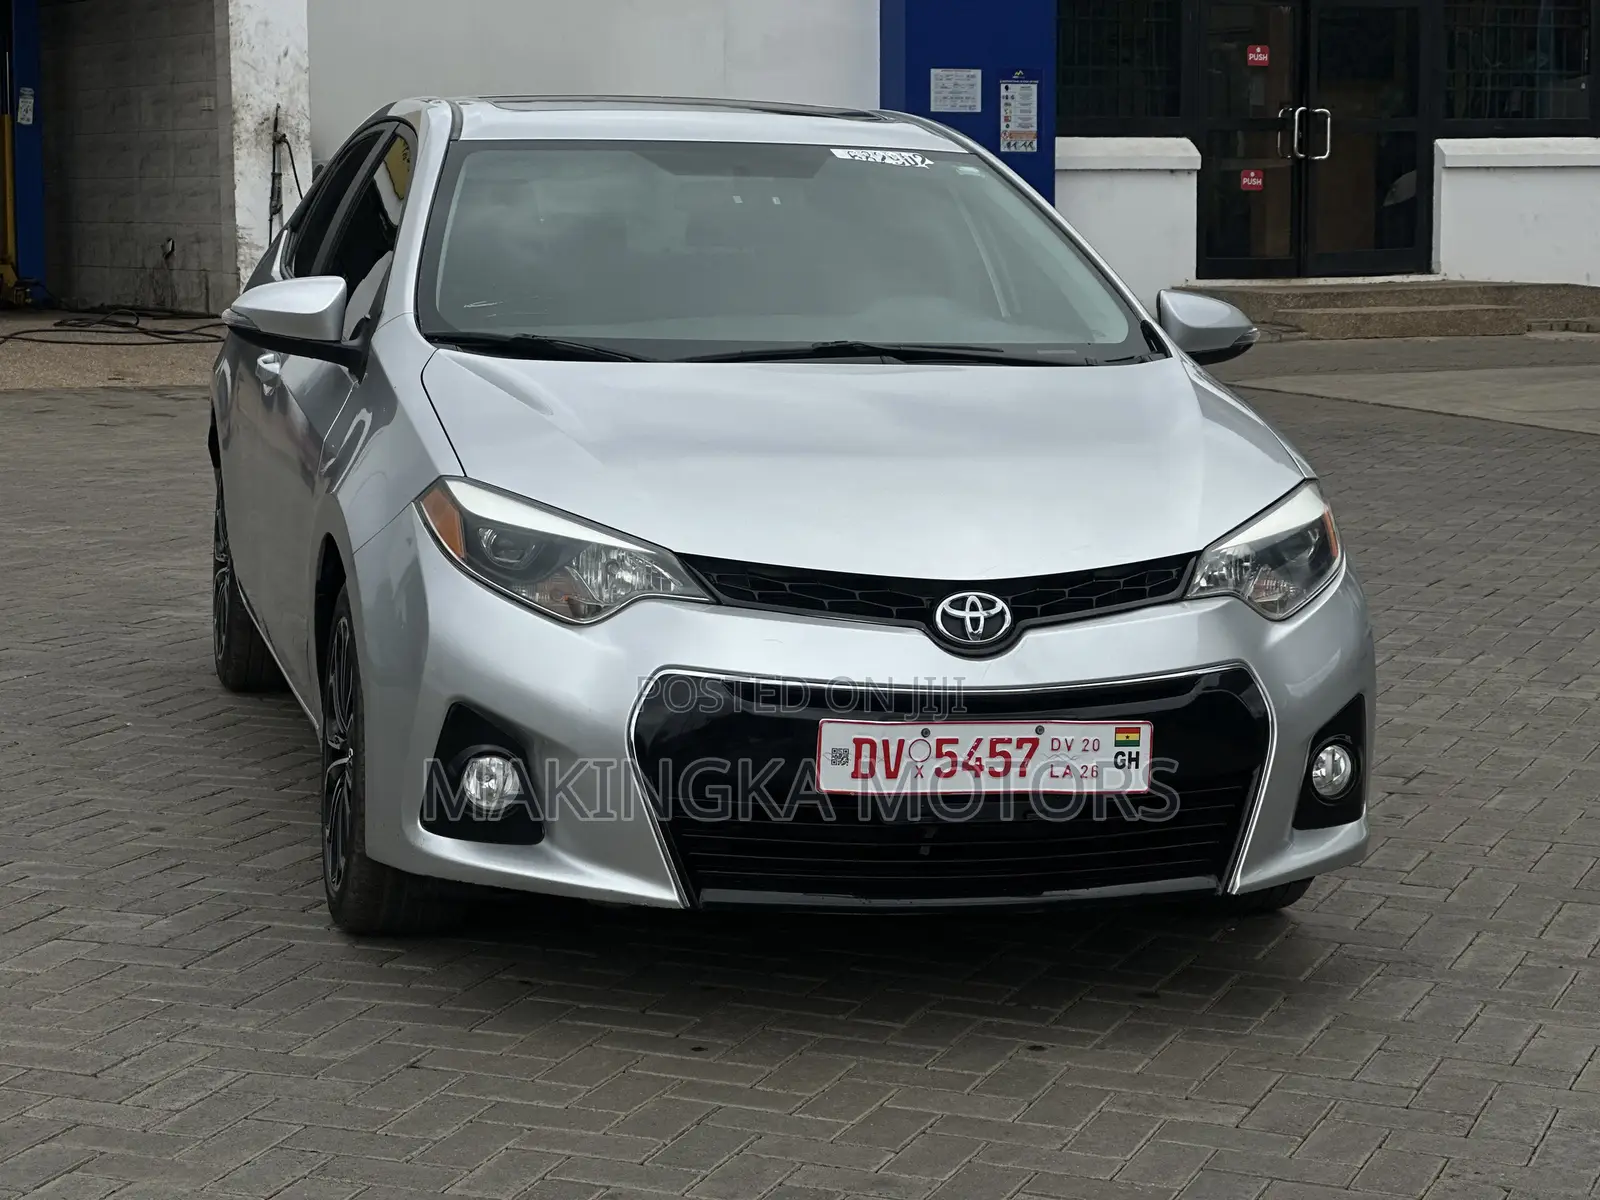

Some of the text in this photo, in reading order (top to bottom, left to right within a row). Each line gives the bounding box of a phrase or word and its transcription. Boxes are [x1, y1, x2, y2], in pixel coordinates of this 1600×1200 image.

[1248, 53, 1268, 61] PUSH
[1242, 177, 1262, 185] PUSH
[1051, 737, 1101, 752] DV 20
[850, 737, 1040, 780] DV 5457
[1113, 750, 1140, 770] GH
[1050, 764, 1099, 779] LA 26
